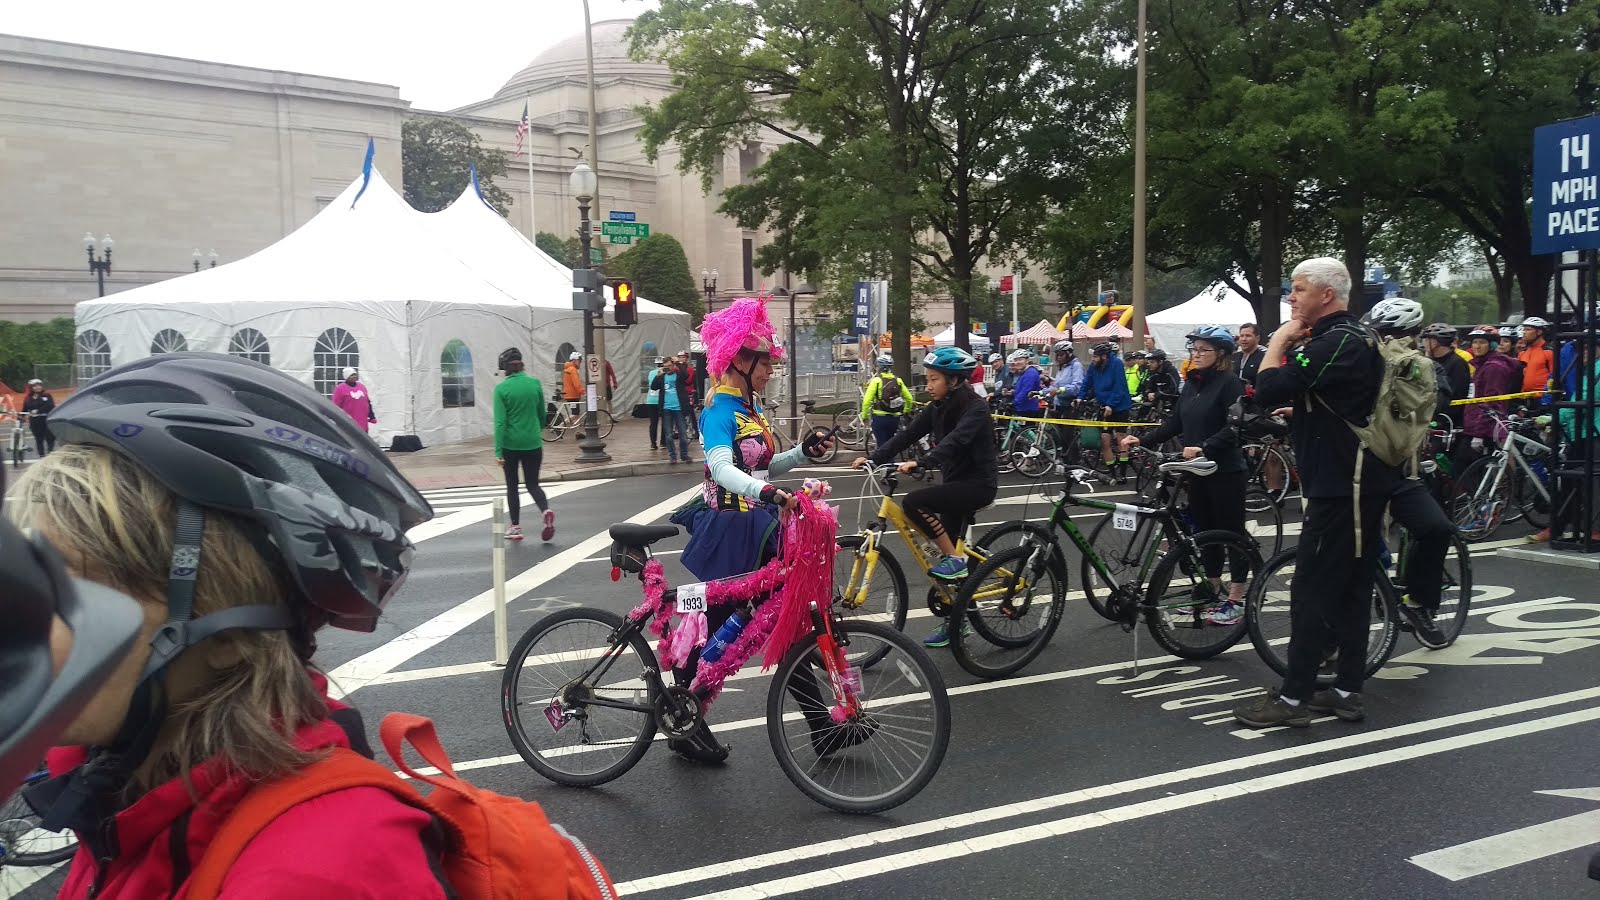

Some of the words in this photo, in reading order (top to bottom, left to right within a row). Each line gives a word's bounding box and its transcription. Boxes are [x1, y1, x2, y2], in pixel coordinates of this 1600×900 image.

[1560, 133, 1590, 173] 14
[1551, 175, 1597, 205] MPH
[1548, 207, 1600, 236] PACE
[604, 223, 636, 236] Pennsylvania
[613, 236, 628, 244] 400
[856, 317, 868, 328] PACE
[682, 597, 703, 611] 1933
